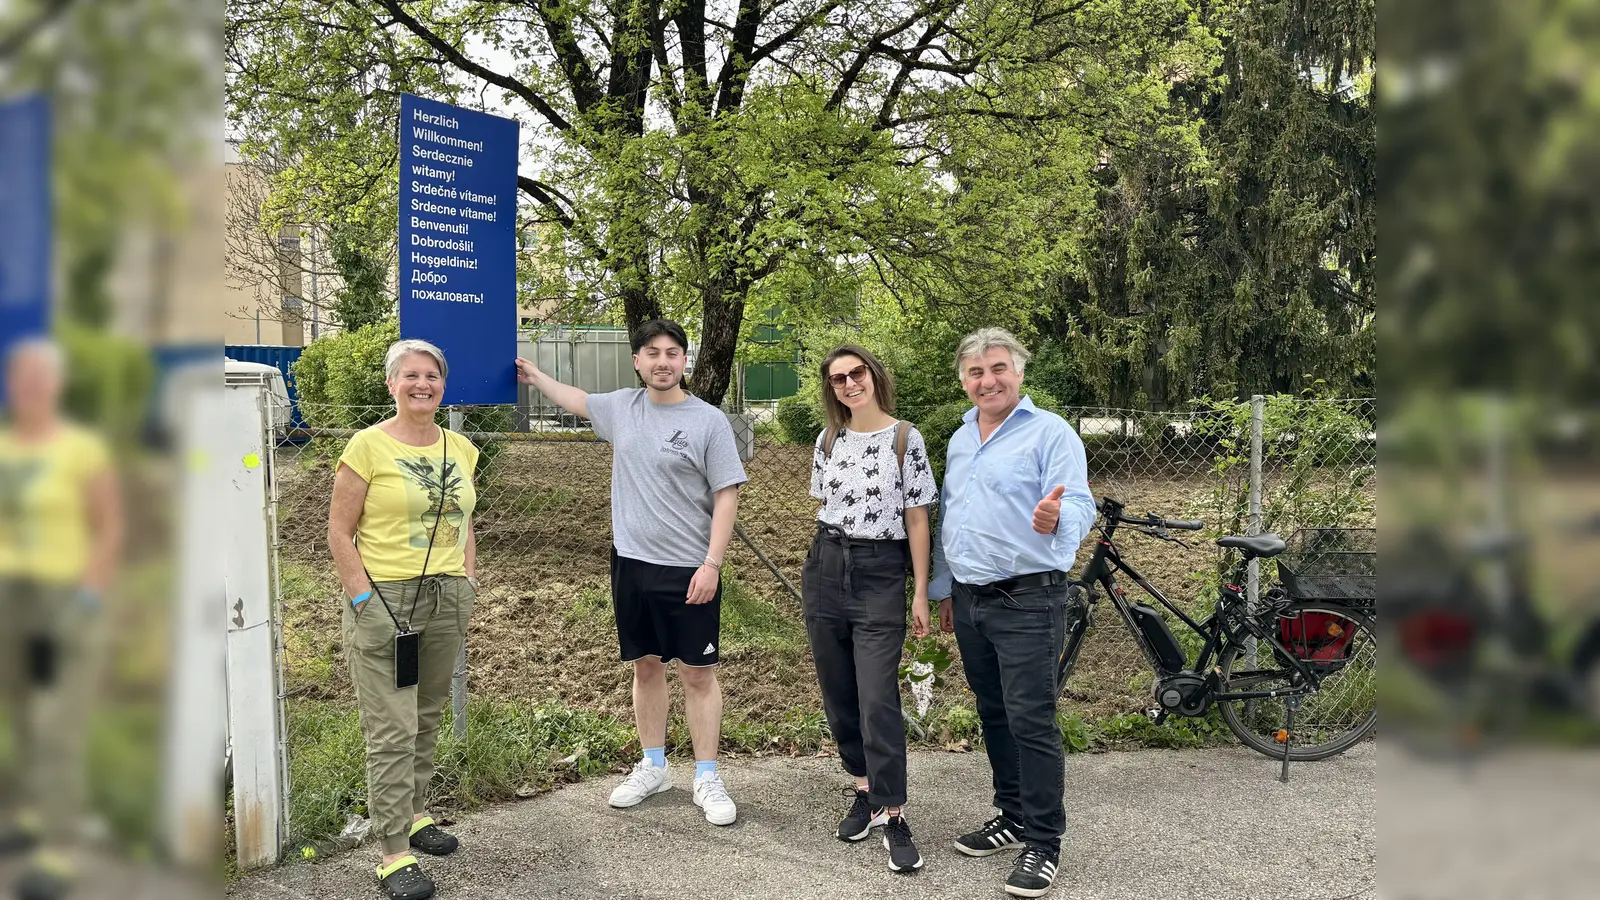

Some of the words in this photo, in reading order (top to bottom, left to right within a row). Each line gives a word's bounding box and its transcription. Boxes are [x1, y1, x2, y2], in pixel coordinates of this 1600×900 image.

[413, 108, 459, 130] Herzlich
[412, 126, 483, 152] Willkommen!
[412, 144, 474, 167] Serdecznie
[411, 165, 456, 183] witamy!
[411, 180, 457, 199] Srdečně
[459, 189, 497, 205] vítame!
[410, 198, 457, 216] Srdecne
[459, 206, 497, 222] vítame!
[411, 216, 469, 235] Benvenuti!
[411, 233, 474, 252] Dobrodošli!
[411, 251, 478, 269] Hoşgeldiniz!
[411, 269, 448, 285] Добро
[411, 289, 484, 304] пожаловать!
